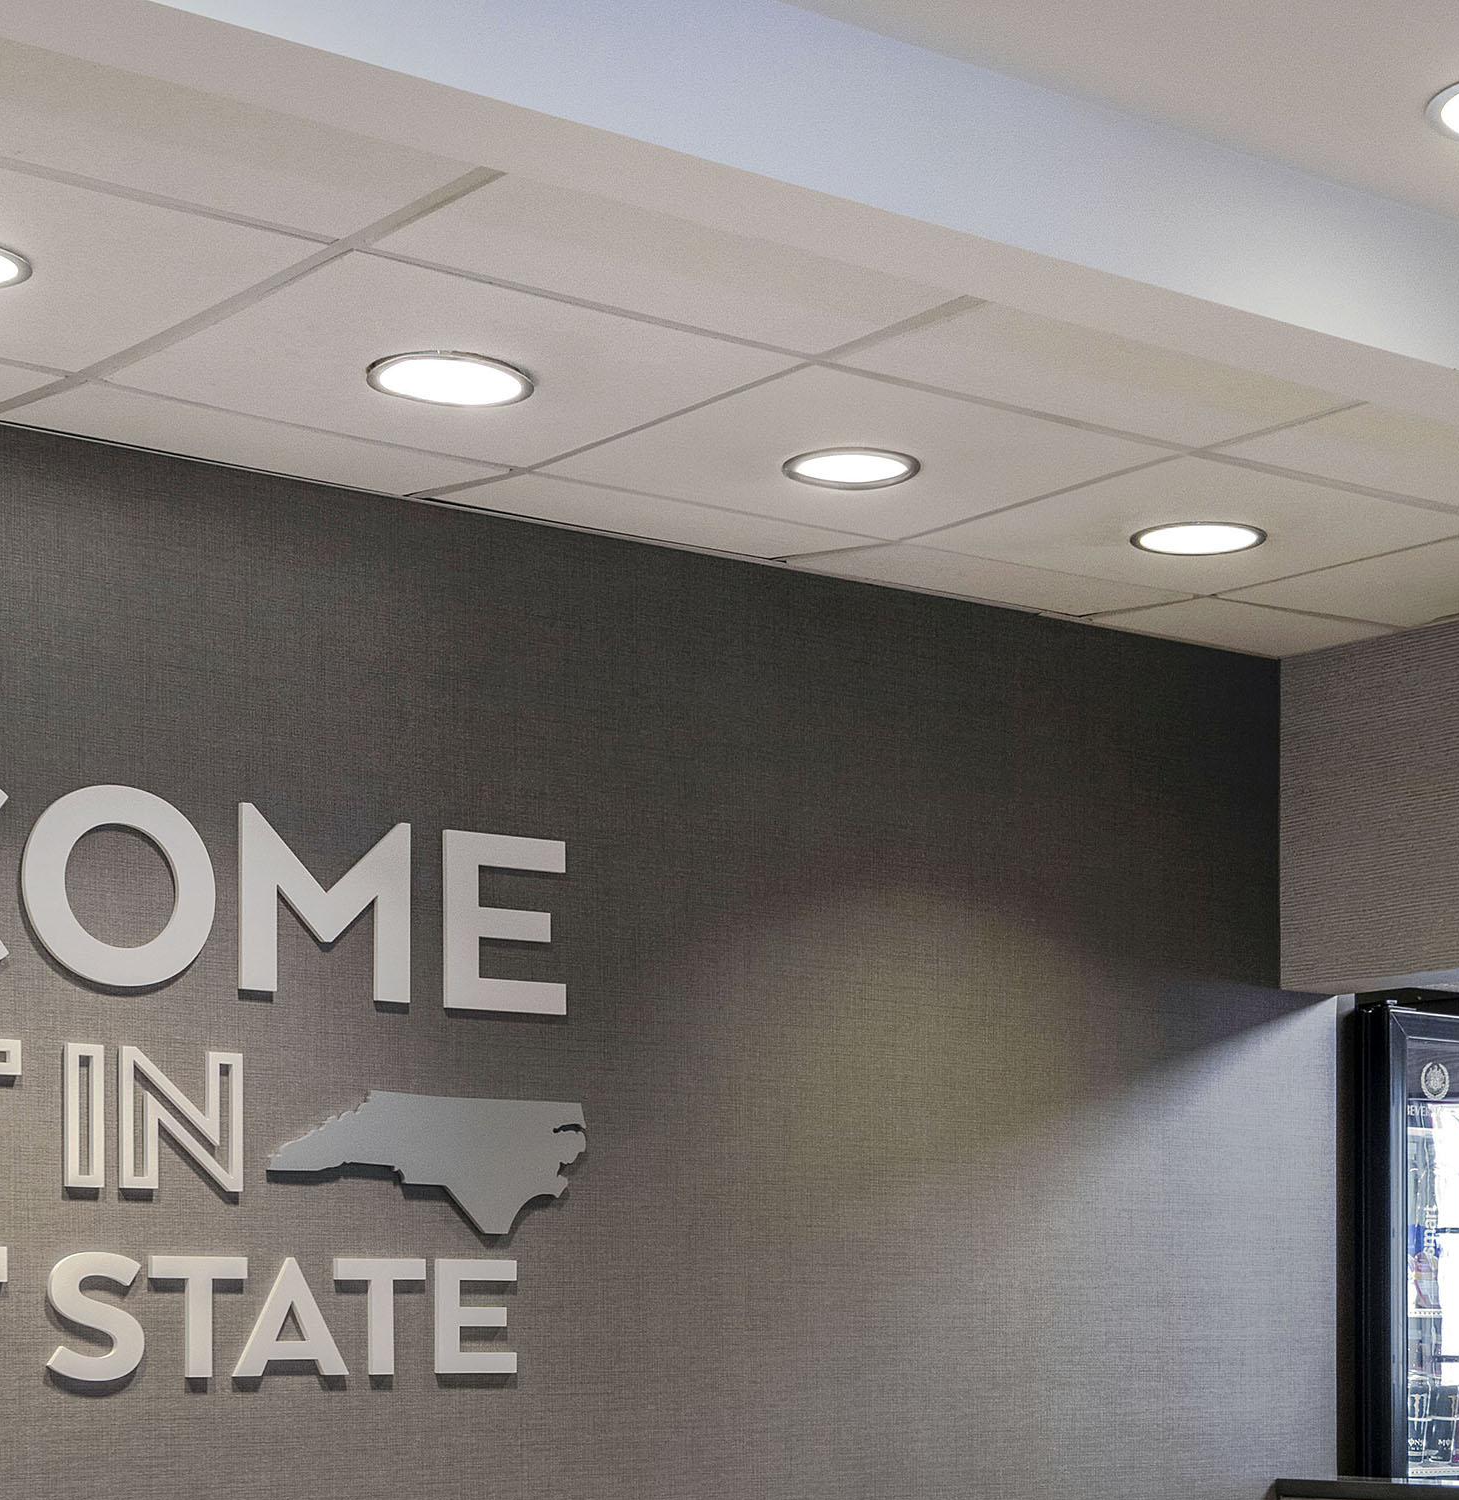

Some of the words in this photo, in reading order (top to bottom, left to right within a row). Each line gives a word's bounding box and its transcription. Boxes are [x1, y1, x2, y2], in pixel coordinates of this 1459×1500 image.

[63, 1042, 246, 1194] IN
[1423, 1204, 1438, 1257] smart
[45, 1250, 519, 1384] STATE
